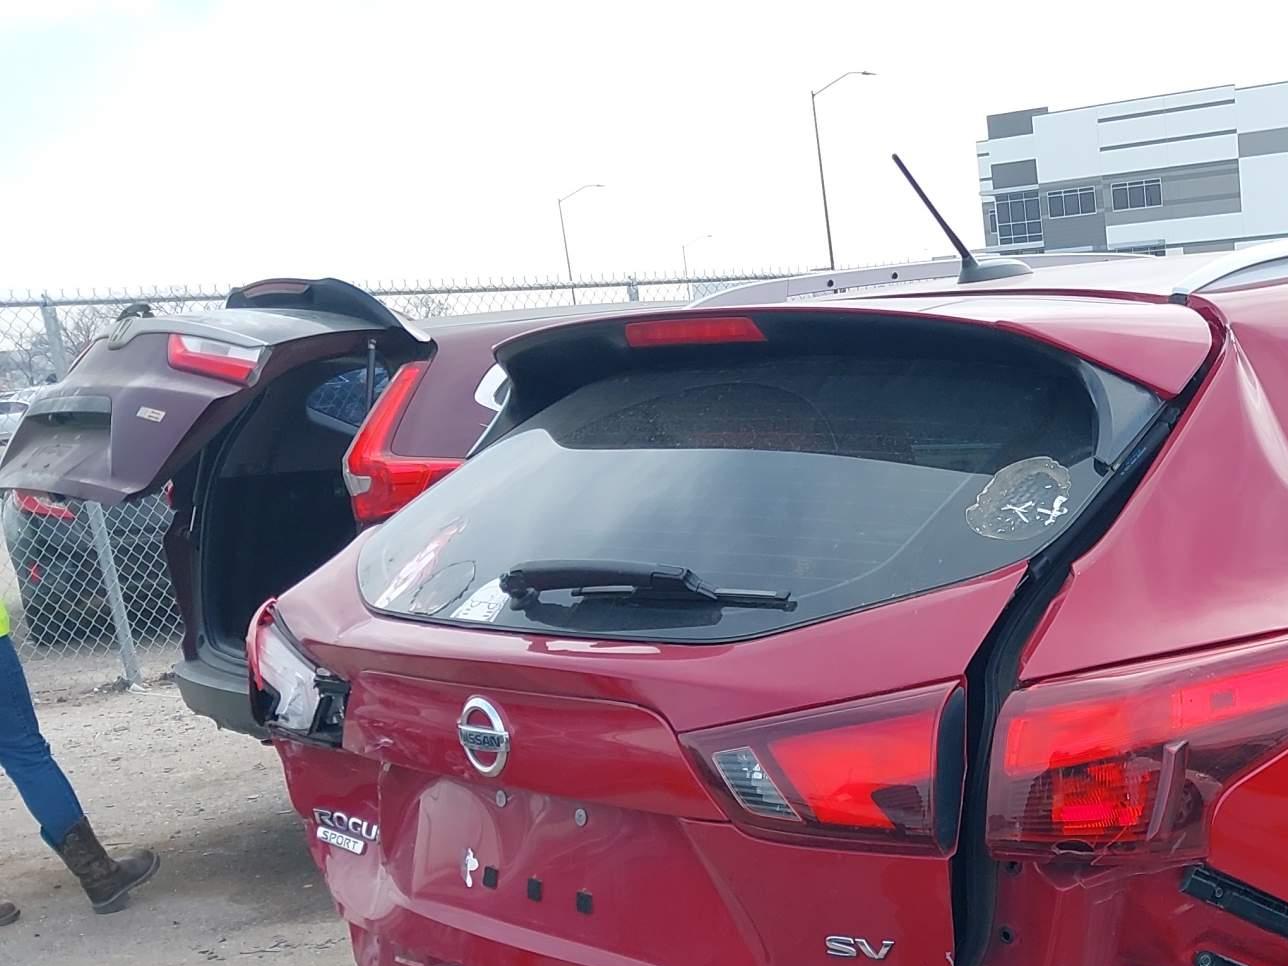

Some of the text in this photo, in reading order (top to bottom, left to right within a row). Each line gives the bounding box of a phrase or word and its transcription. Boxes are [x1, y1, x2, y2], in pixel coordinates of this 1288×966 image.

[312, 807, 380, 841] ROGU
[321, 830, 359, 850] SPORT
[825, 936, 895, 960] SV
